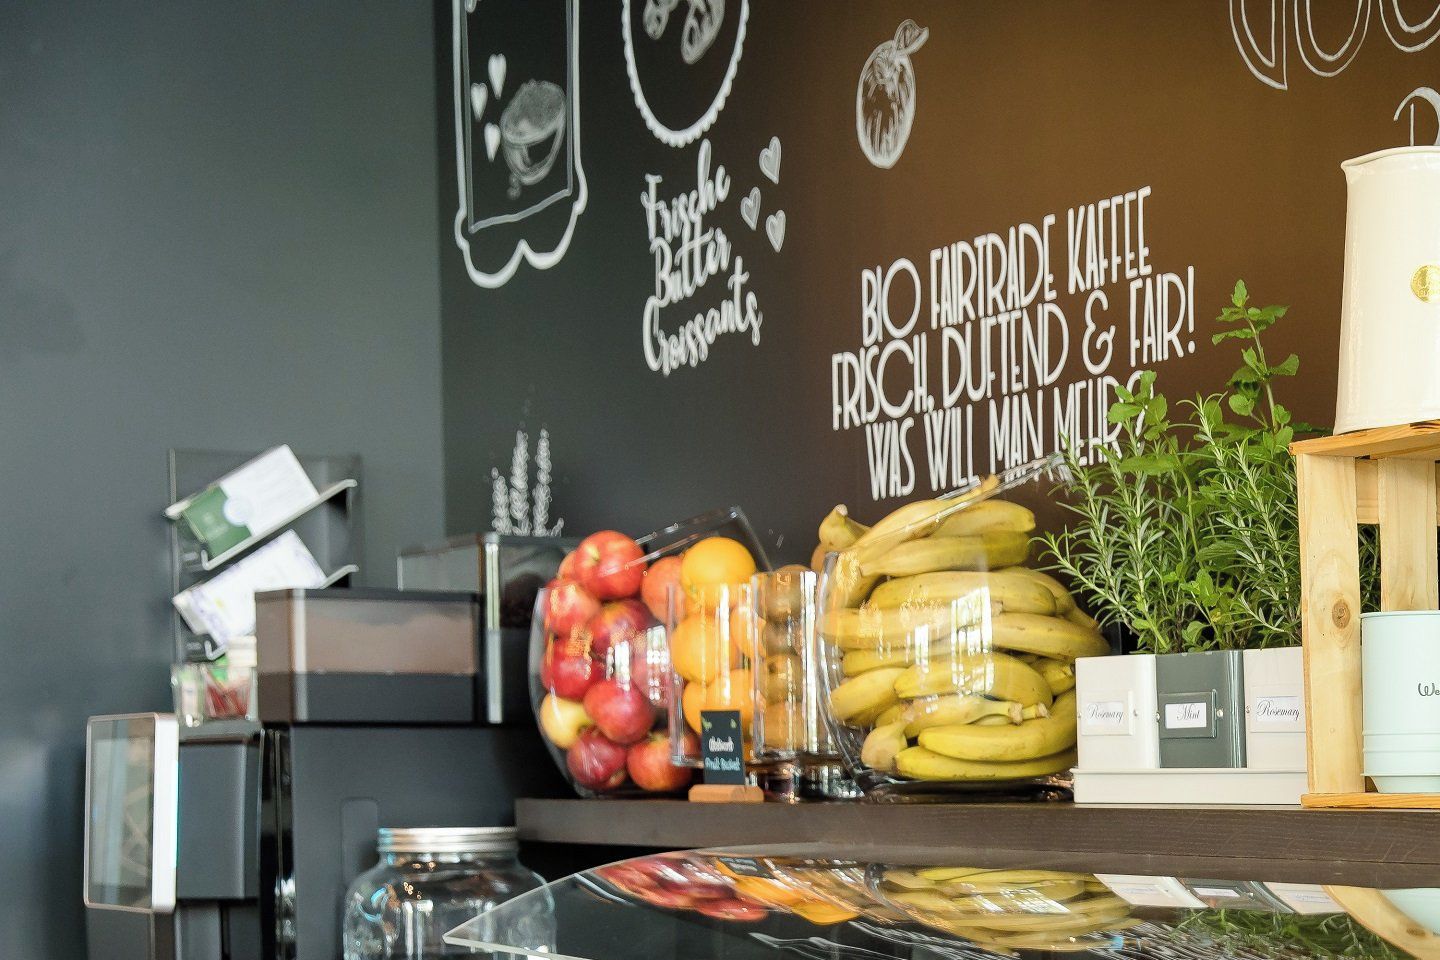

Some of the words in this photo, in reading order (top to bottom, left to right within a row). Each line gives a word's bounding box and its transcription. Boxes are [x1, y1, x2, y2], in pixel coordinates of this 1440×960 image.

[650, 226, 731, 308] Butter
[861, 257, 922, 347] BIO
[930, 213, 1056, 330] FAIRTRADE
[1067, 185, 1151, 295] KAFFEE
[642, 255, 764, 377] Croissants
[942, 302, 1070, 409] DUFTEND
[1082, 289, 1115, 375] &
[1129, 265, 1196, 367] FAIR!
[866, 417, 914, 500] WAS
[924, 404, 980, 491] WILL
[989, 390, 1044, 482] MAN
[1087, 703, 1124, 722] Rosemary
[1176, 704, 1200, 720] Mint
[1256, 700, 1300, 721] Rosemary
